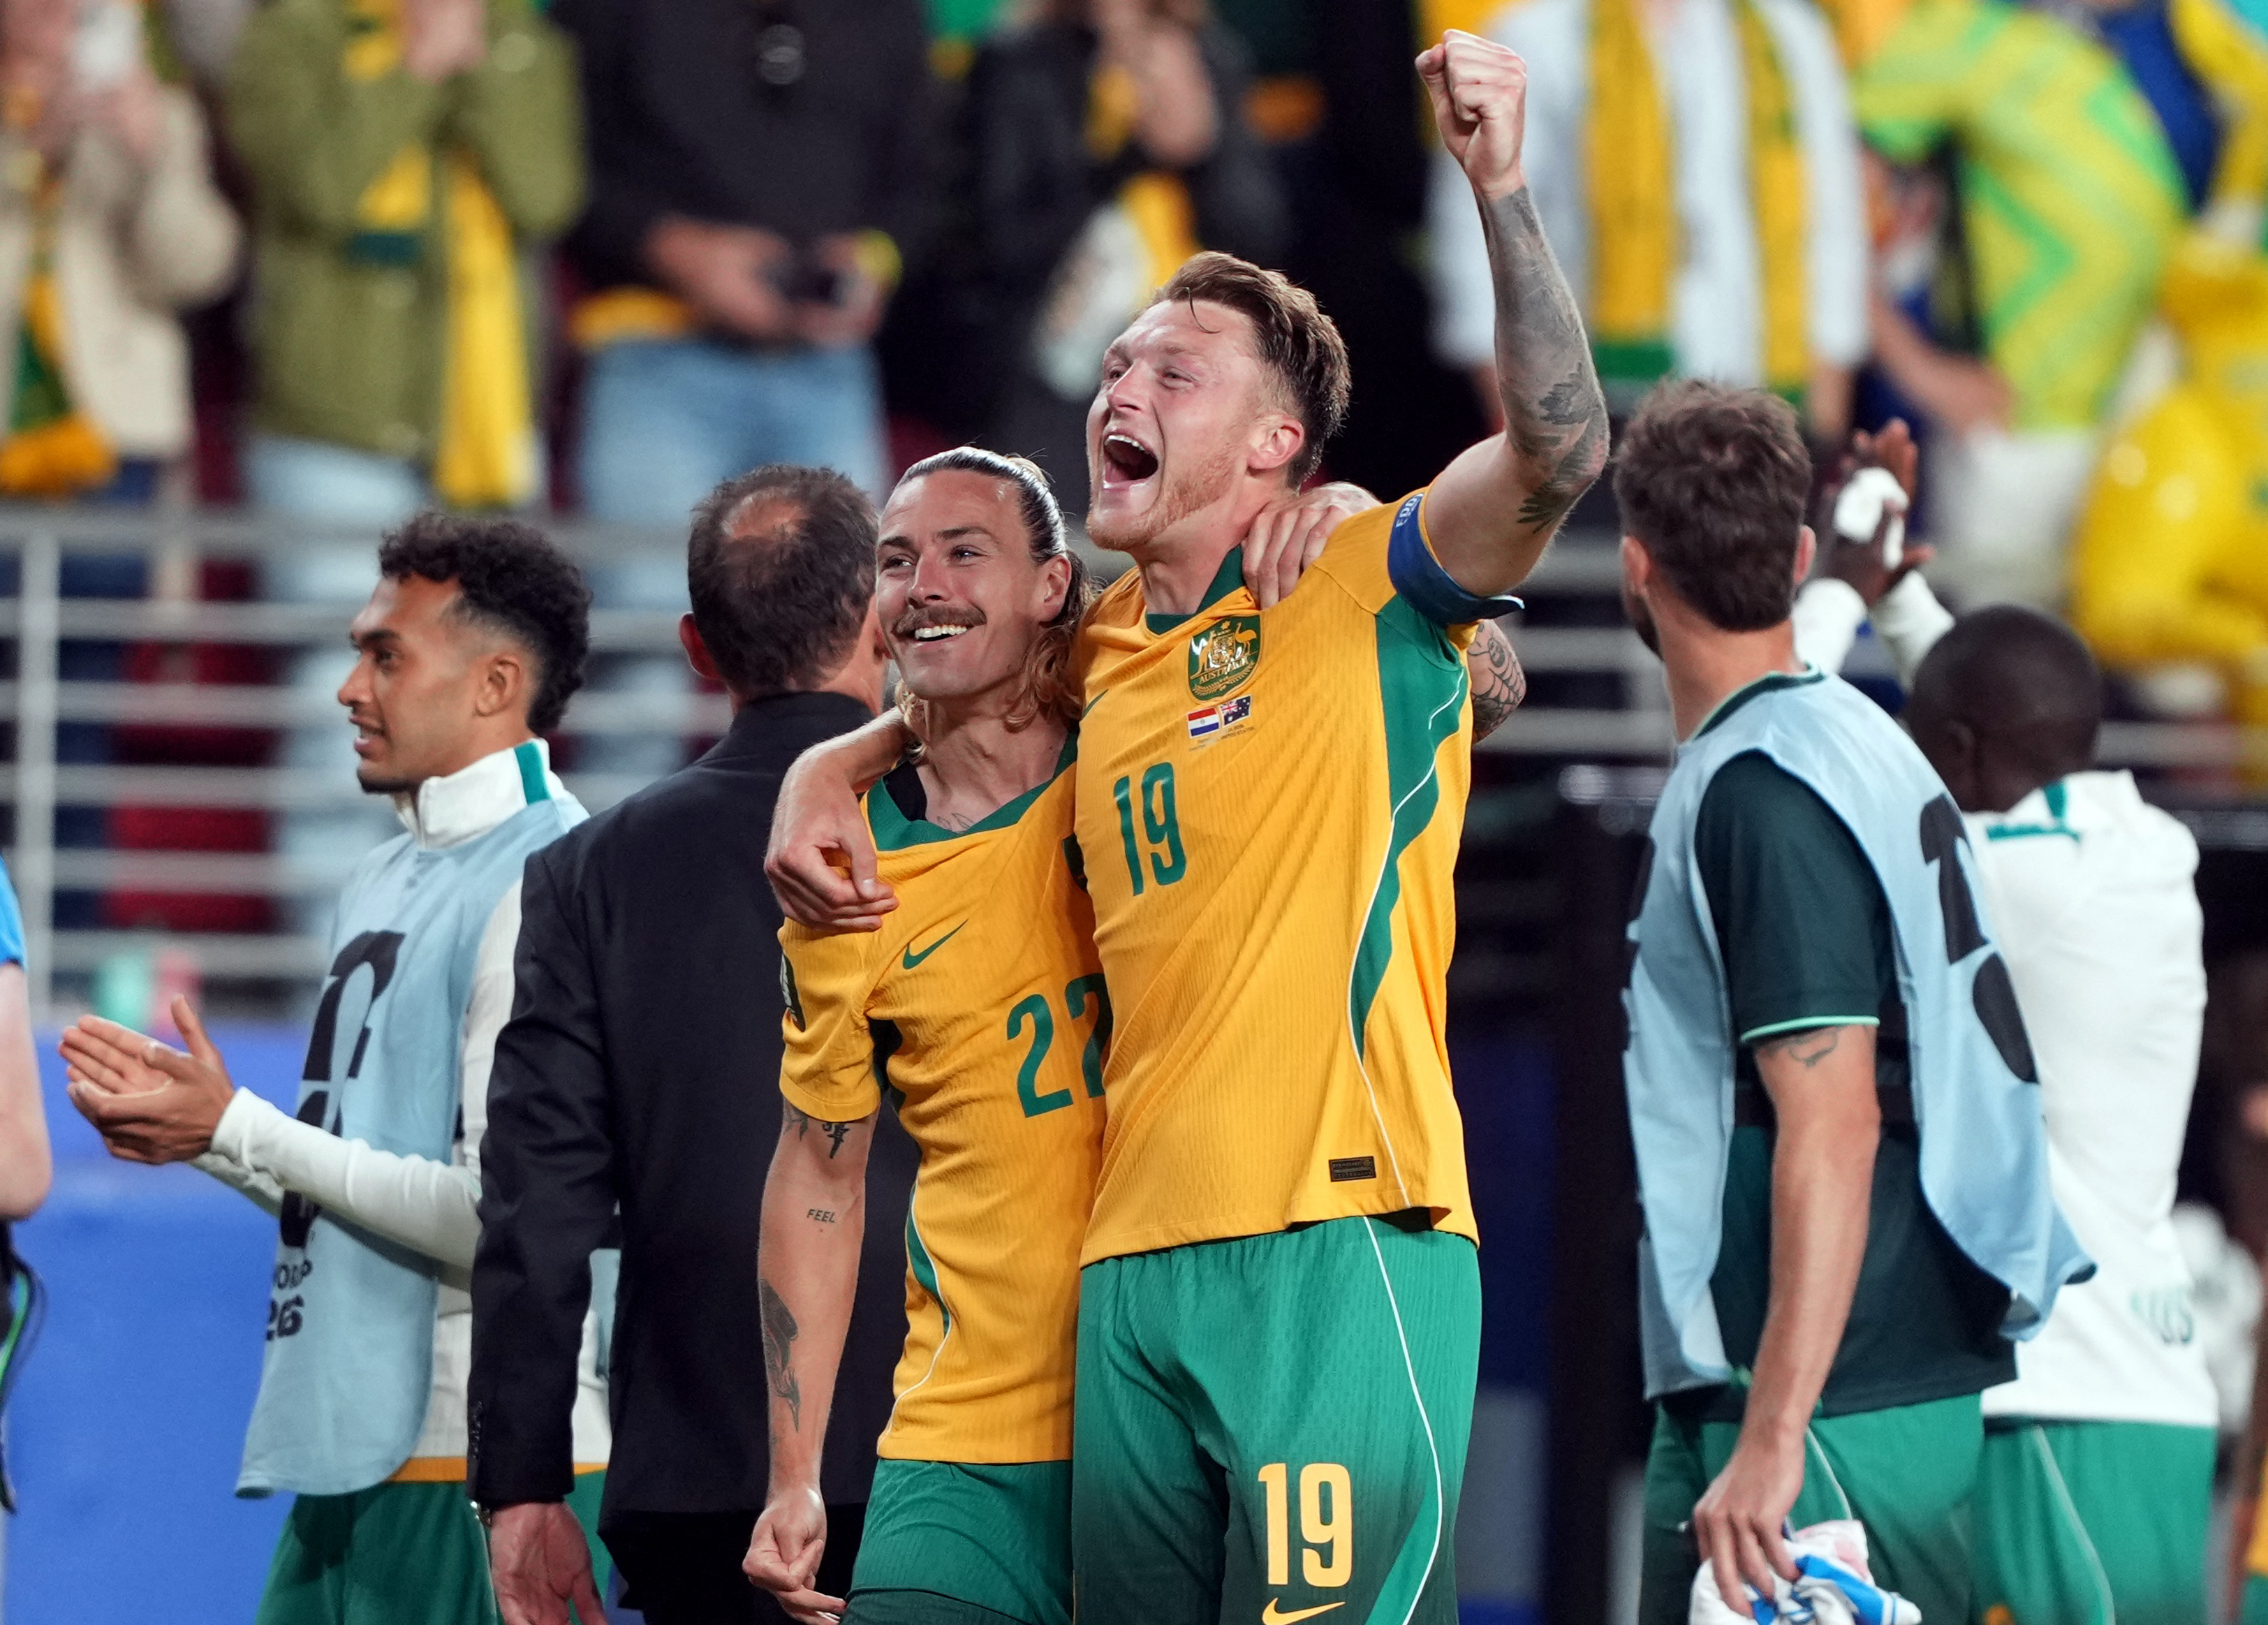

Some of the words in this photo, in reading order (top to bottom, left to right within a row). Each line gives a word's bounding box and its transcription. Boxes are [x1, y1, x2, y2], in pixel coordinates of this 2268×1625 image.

[1200, 657, 1249, 684] AUSTRALIA
[1113, 761, 1187, 897] 19
[1007, 972, 1114, 1118] 22
[807, 1209, 835, 1223] FEEL
[1258, 1462, 1353, 1588] 19
